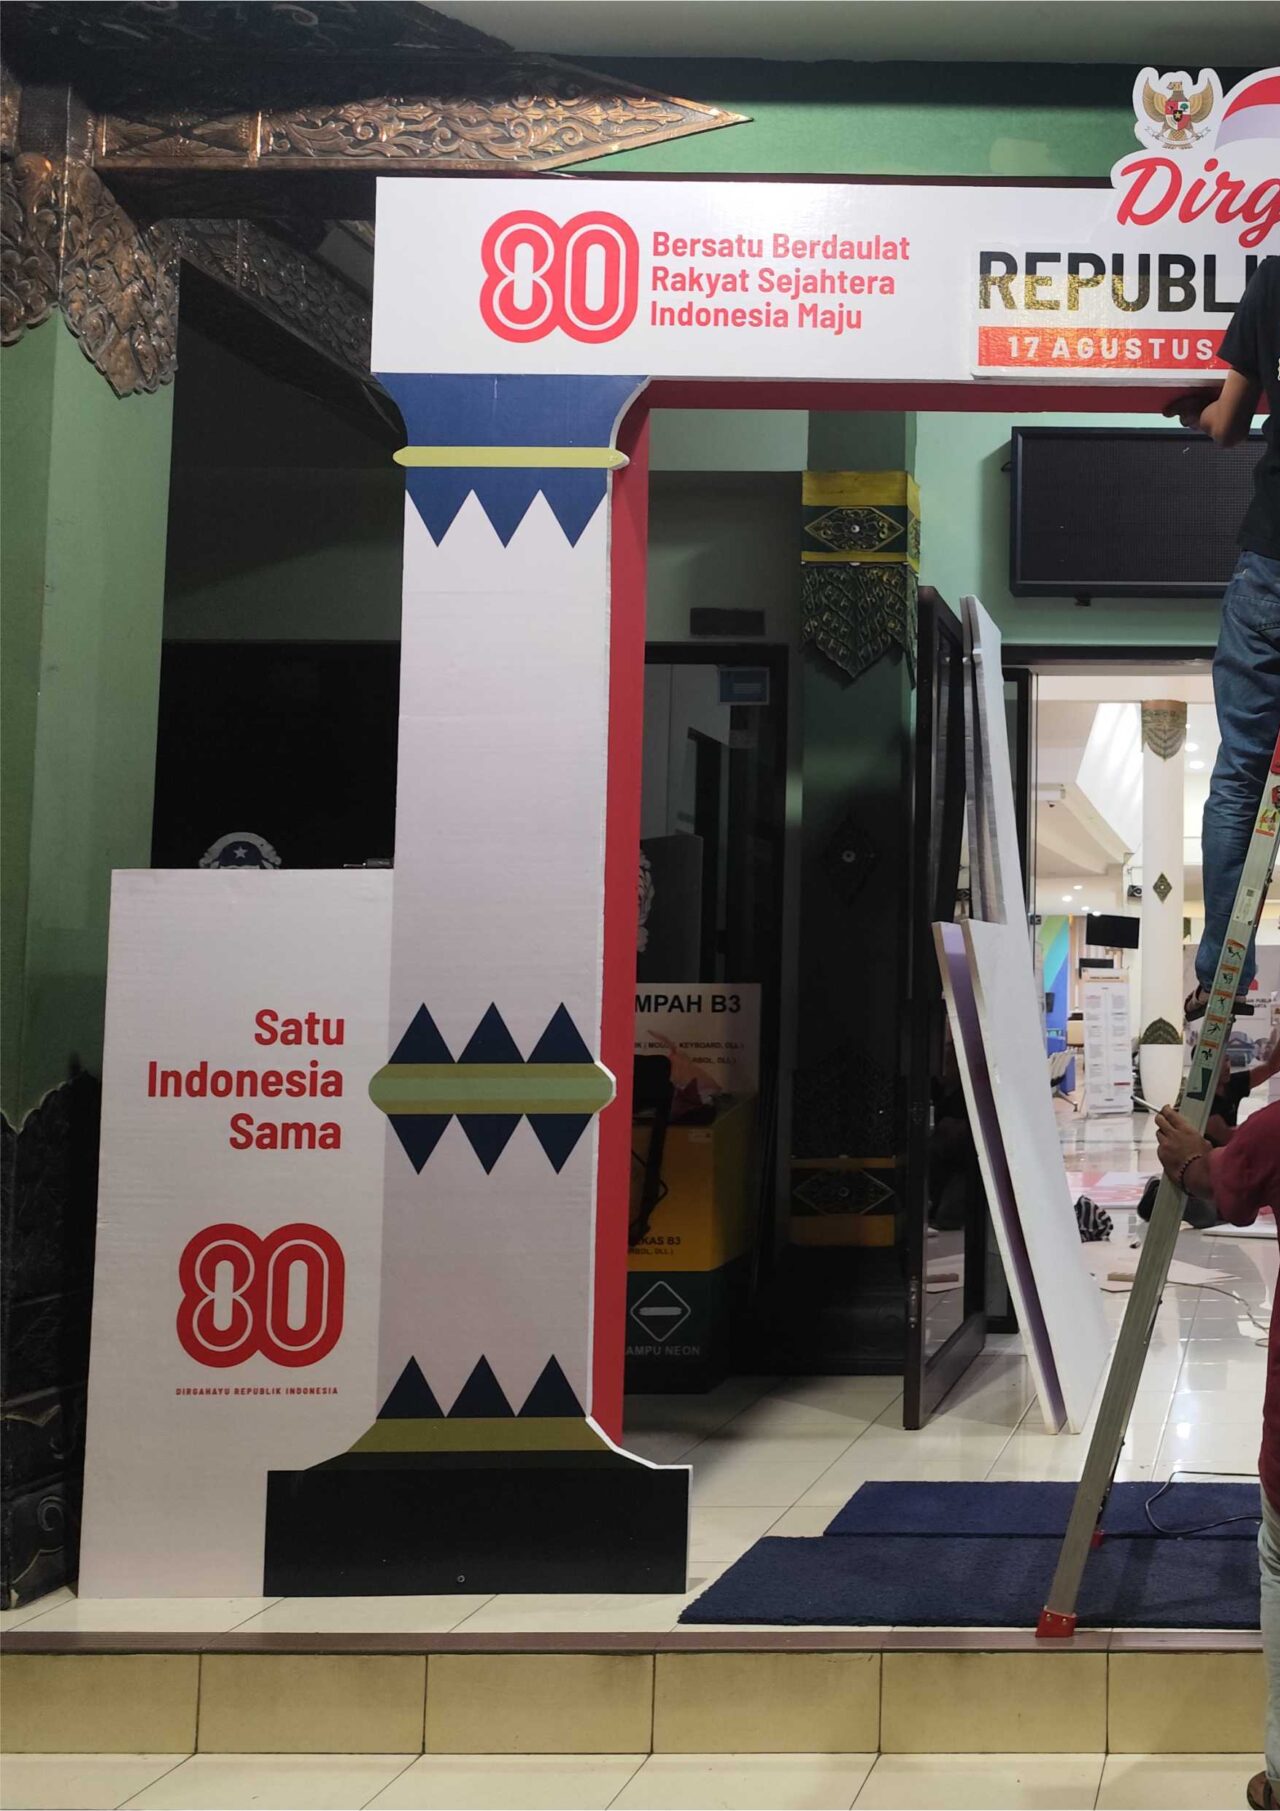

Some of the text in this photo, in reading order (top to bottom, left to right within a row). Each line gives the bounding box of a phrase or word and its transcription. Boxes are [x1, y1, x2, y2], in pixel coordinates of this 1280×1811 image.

[653, 231, 909, 261] Bersatu Berdaulat
[480, 210, 640, 344] 80
[652, 266, 895, 300] Rakyat Sejahtera
[650, 300, 862, 335] Indonesia Maju
[1008, 336, 1040, 358] 17
[1051, 337, 1213, 360] AGUSTUS
[634, 994, 741, 1014] MPAH B3
[254, 1008, 345, 1046] Satu
[148, 1059, 343, 1098] Indonesia
[229, 1113, 341, 1150] Sama
[176, 1222, 346, 1368] 80
[626, 1345, 701, 1356] AMPU NEON
[175, 1386, 338, 1396] DIRGAHAYU REPUBLIK INDONESIA
